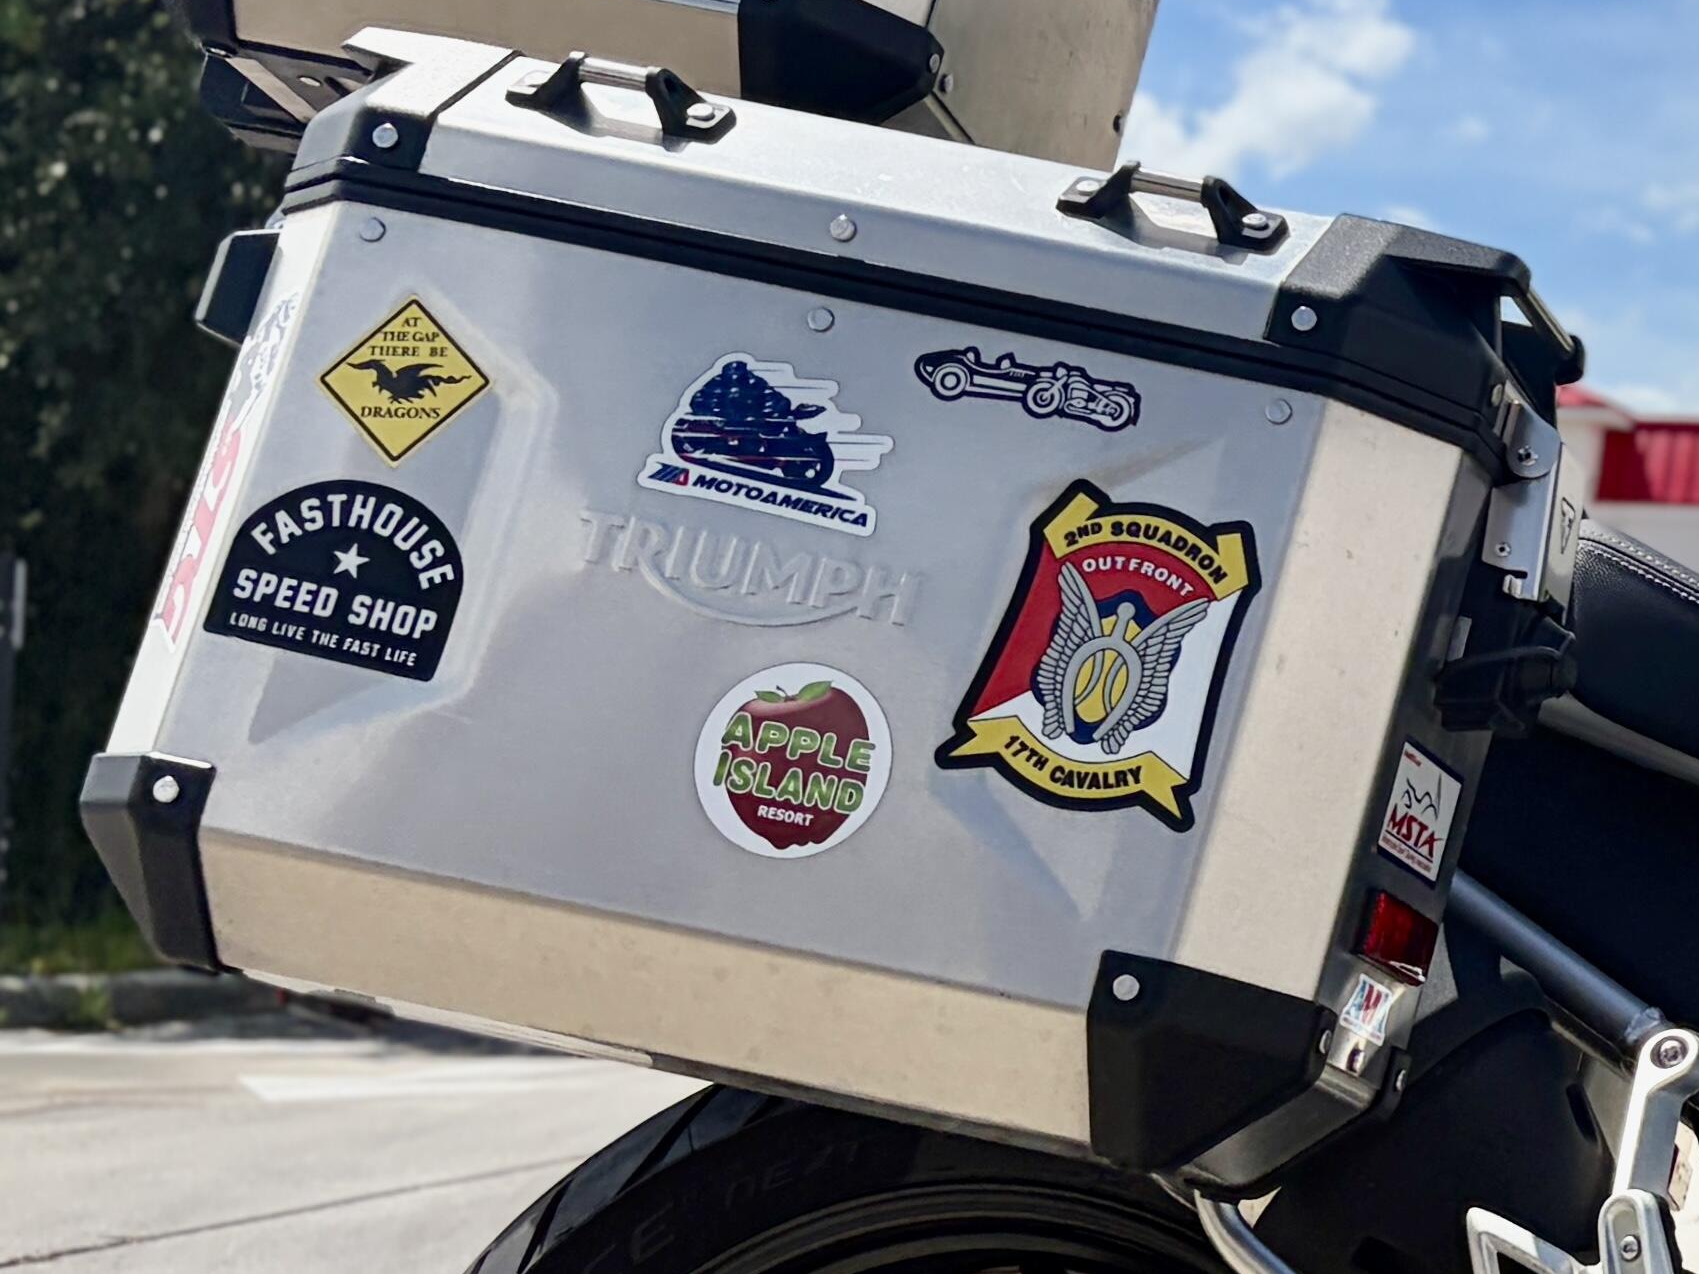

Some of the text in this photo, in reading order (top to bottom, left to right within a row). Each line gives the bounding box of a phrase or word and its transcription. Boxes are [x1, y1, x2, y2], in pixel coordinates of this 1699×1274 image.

[382, 331, 439, 342] THE GAP
[402, 317, 421, 327] AT
[369, 346, 448, 357] THERE BE
[360, 406, 440, 419] DRAGONS
[692, 474, 869, 527] MOTOAMERICA
[250, 493, 455, 590] FASTHOUSE
[580, 510, 922, 627] TRIUMPH
[1064, 521, 1228, 585] 2ND SQUADRON
[233, 568, 438, 639] SPEED SHOP
[229, 612, 417, 666] LONG LIVE THE FAST LIFE
[721, 711, 876, 774] APPLE
[1004, 735, 1142, 790] 17TH CAVALRY
[713, 749, 865, 814] ISLAND
[757, 805, 814, 827] RESORT
[1387, 802, 1444, 859] MSTA
